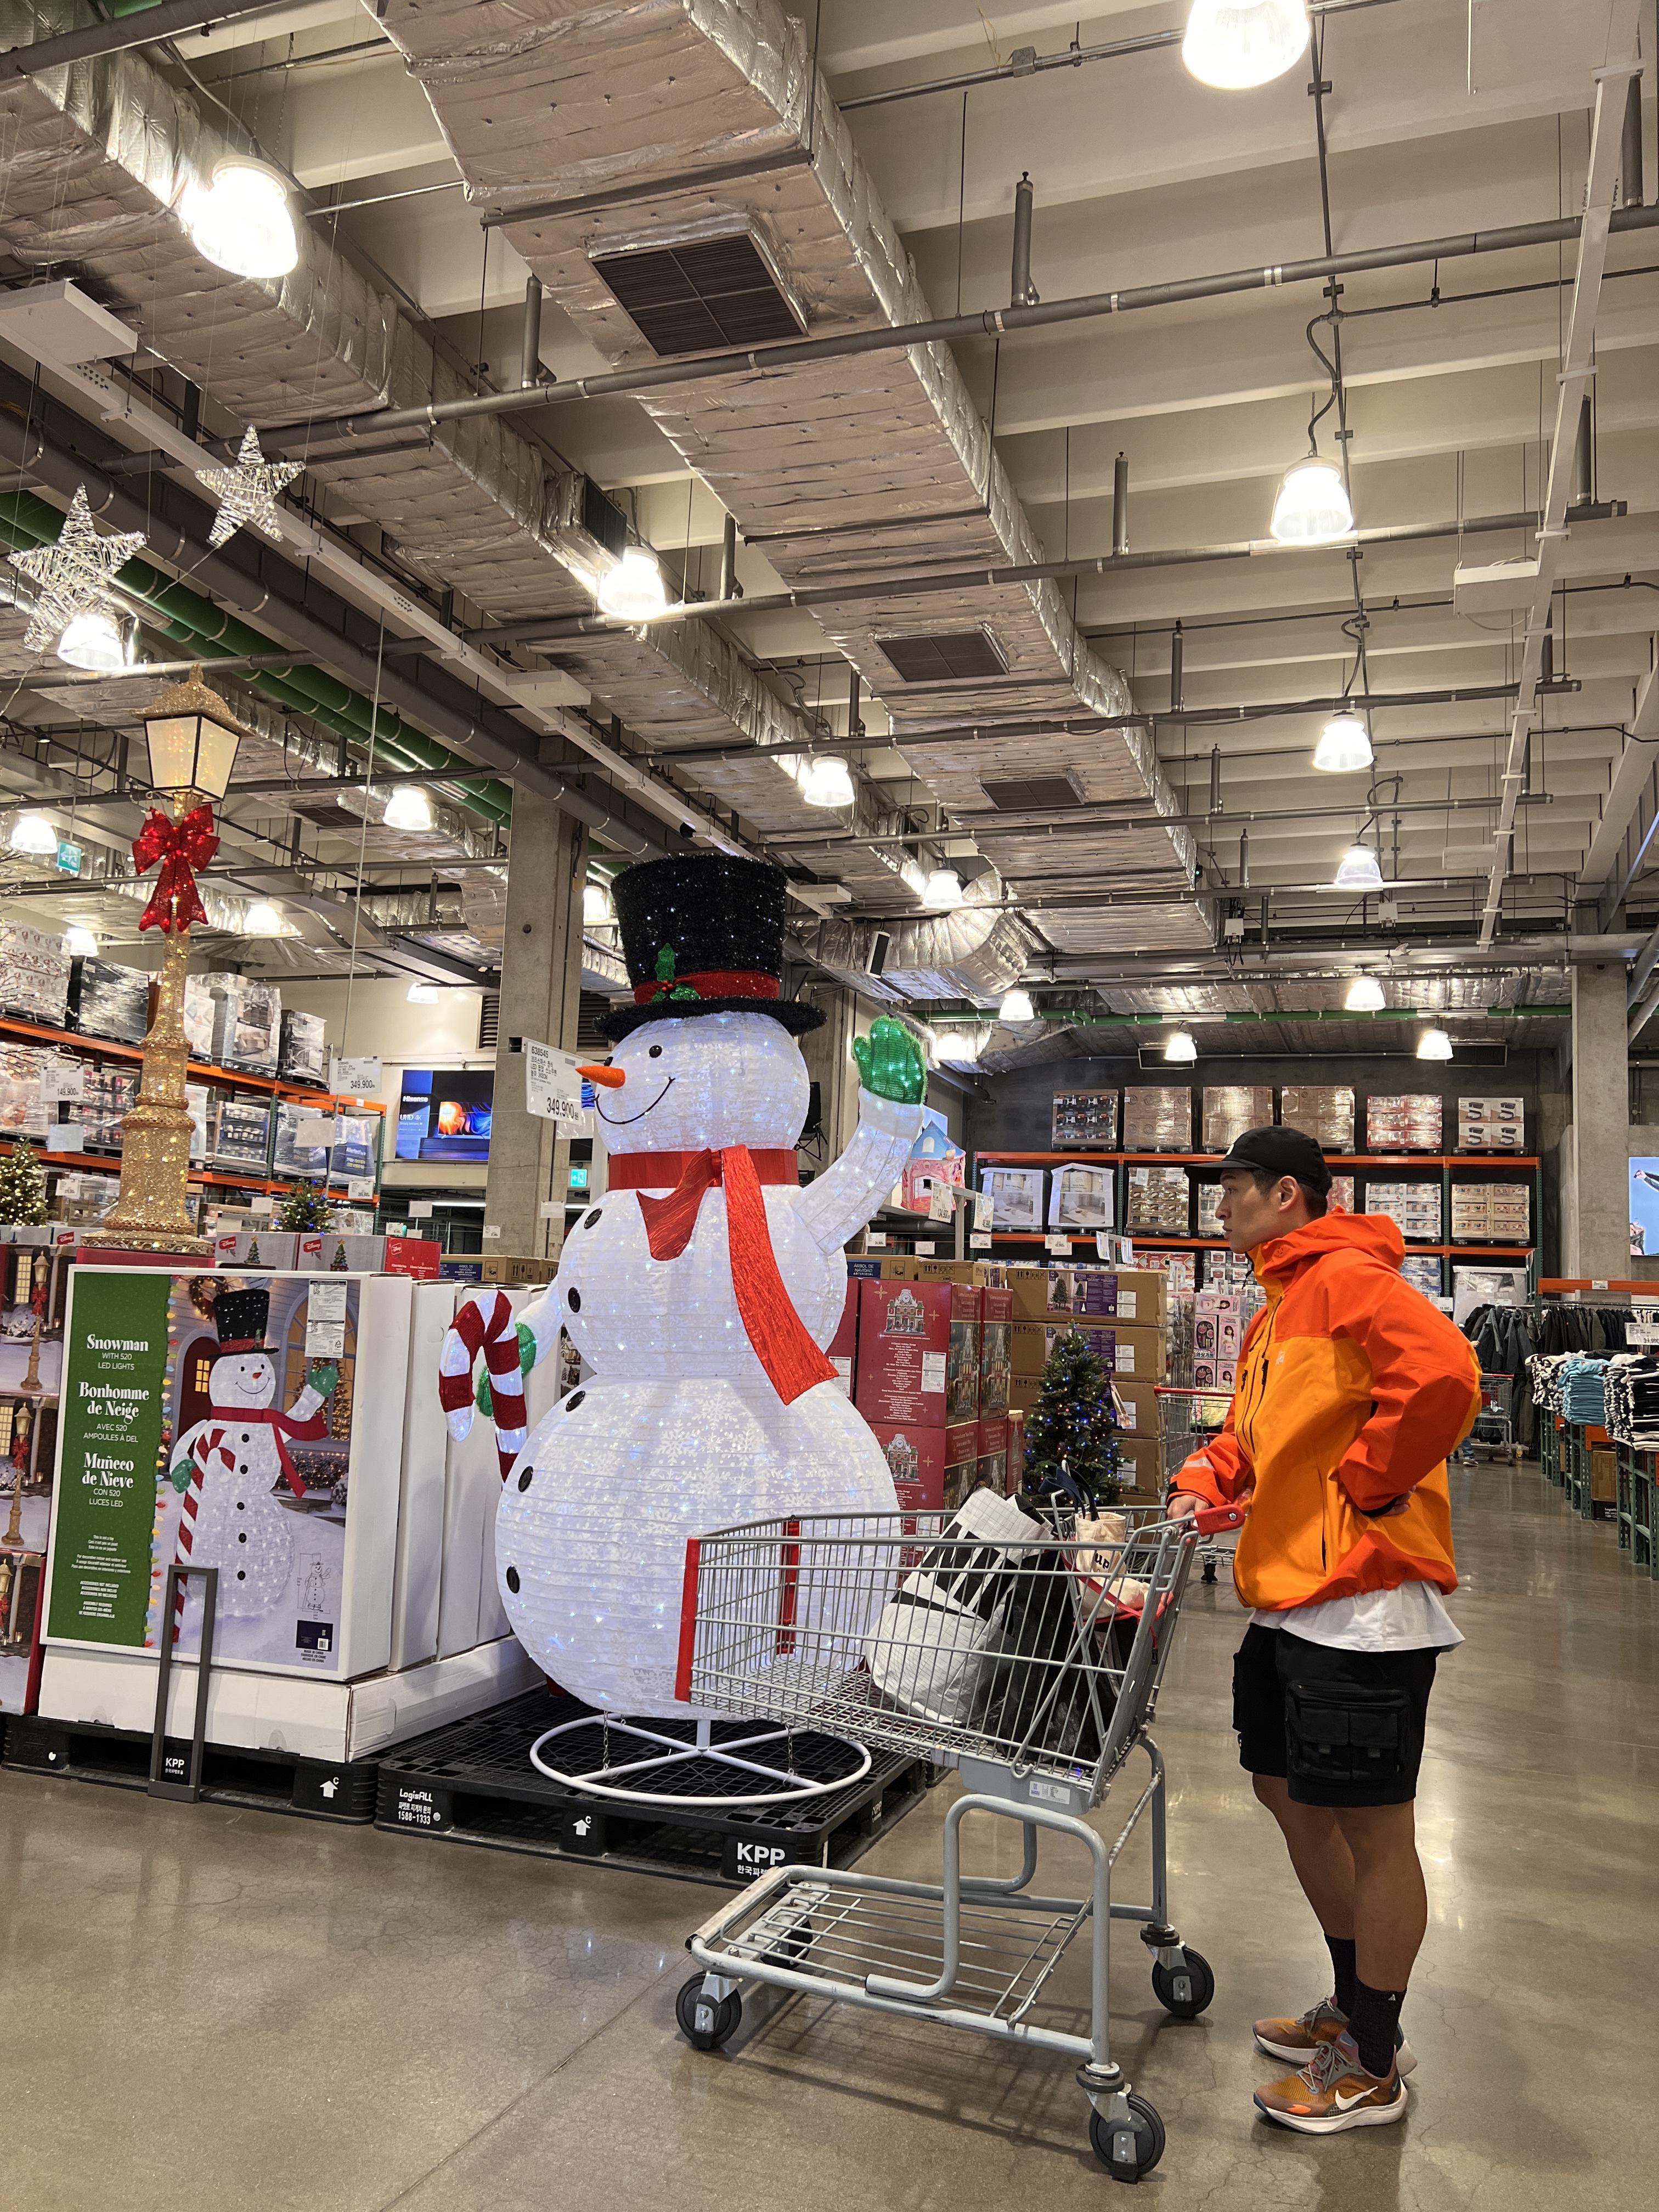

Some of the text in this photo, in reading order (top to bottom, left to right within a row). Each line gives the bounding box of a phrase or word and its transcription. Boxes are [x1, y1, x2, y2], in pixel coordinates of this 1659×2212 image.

[532, 1046, 549, 1058] 638545
[87, 1334, 149, 1352] Snowman
[78, 1381, 149, 1400] Bonhomme
[87, 1400, 139, 1424] de Neige
[83, 1432, 119, 1441] AMPOULES
[83, 1452, 134, 1471] Muñeco
[82, 1470, 133, 1488] de Nieve
[89, 1498, 110, 1506] LUCES
[165, 1757, 184, 1768] KPP
[399, 1788, 433, 1802] LogisALL
[398, 1811, 431, 1825] 1588-1333
[737, 1842, 786, 1865] KPP
